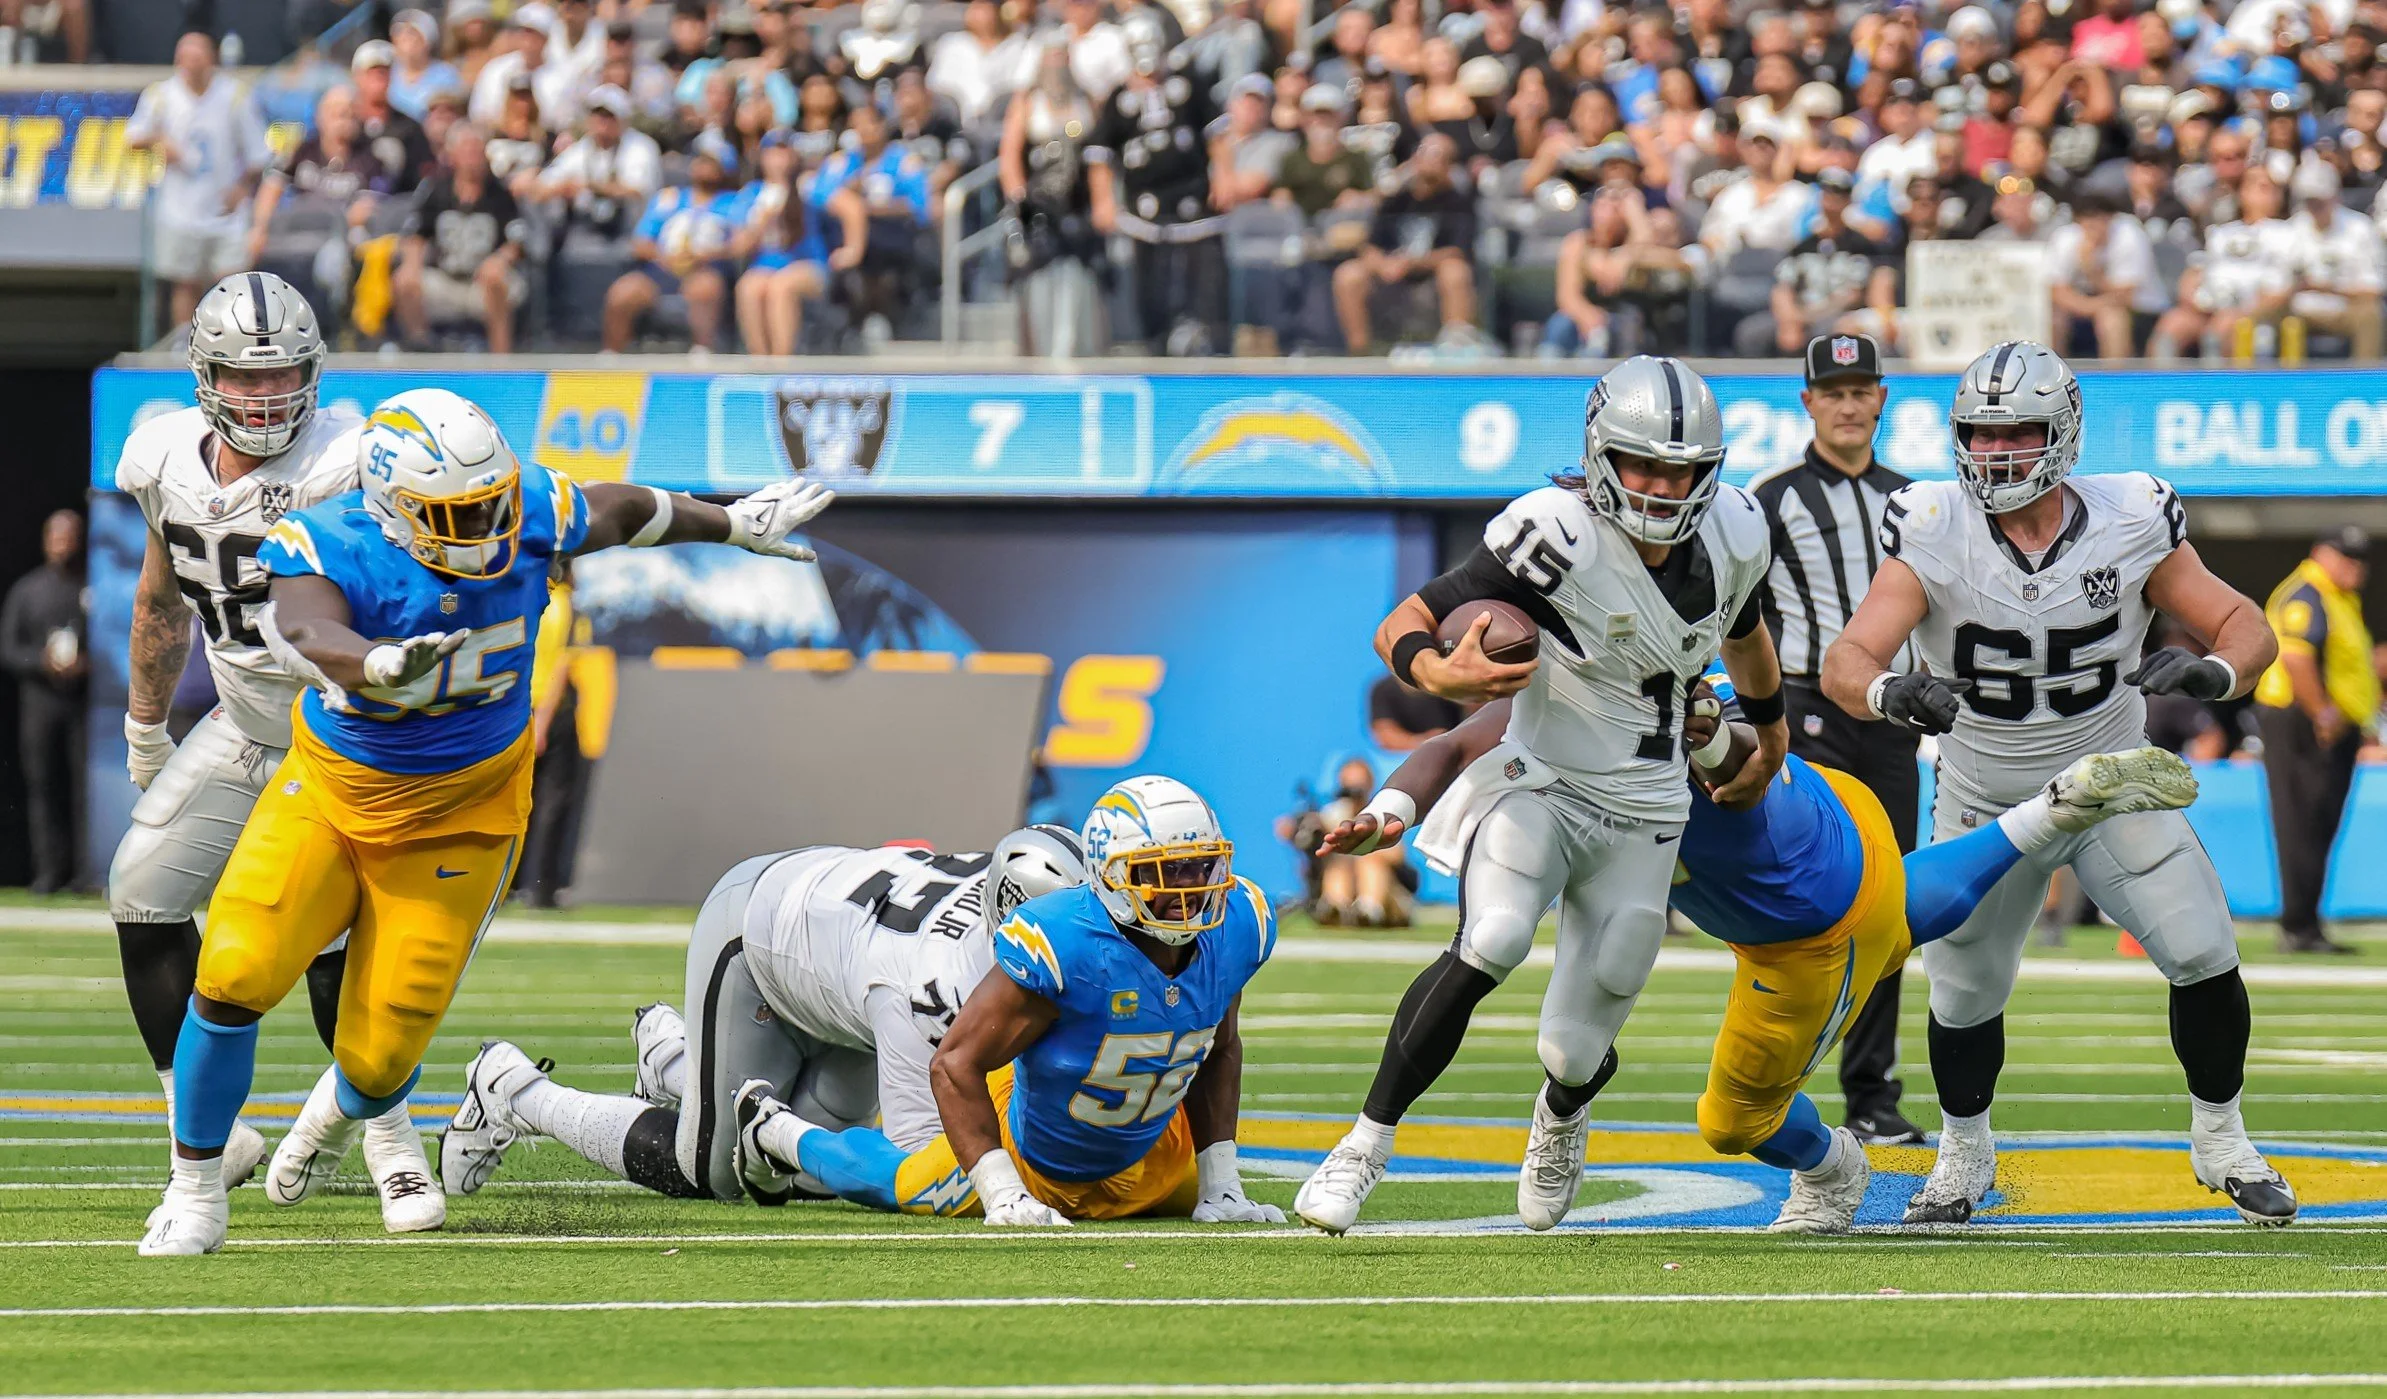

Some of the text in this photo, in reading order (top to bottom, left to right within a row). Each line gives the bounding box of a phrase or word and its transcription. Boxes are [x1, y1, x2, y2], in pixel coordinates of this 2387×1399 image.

[549, 408, 628, 453] 40
[969, 401, 1025, 470] 7
[1459, 400, 1518, 472] 9
[2155, 400, 2320, 467] BALL
[2327, 399, 2387, 467] O
[367, 442, 398, 483] 95
[1494, 517, 1575, 594] 15
[1953, 610, 2121, 722] 65
[1088, 826, 1111, 862] 52
[1003, 878, 1027, 903] RAIDER
[930, 910, 969, 941] JR
[1111, 991, 1139, 1015] C
[1068, 1026, 1217, 1127] 52
